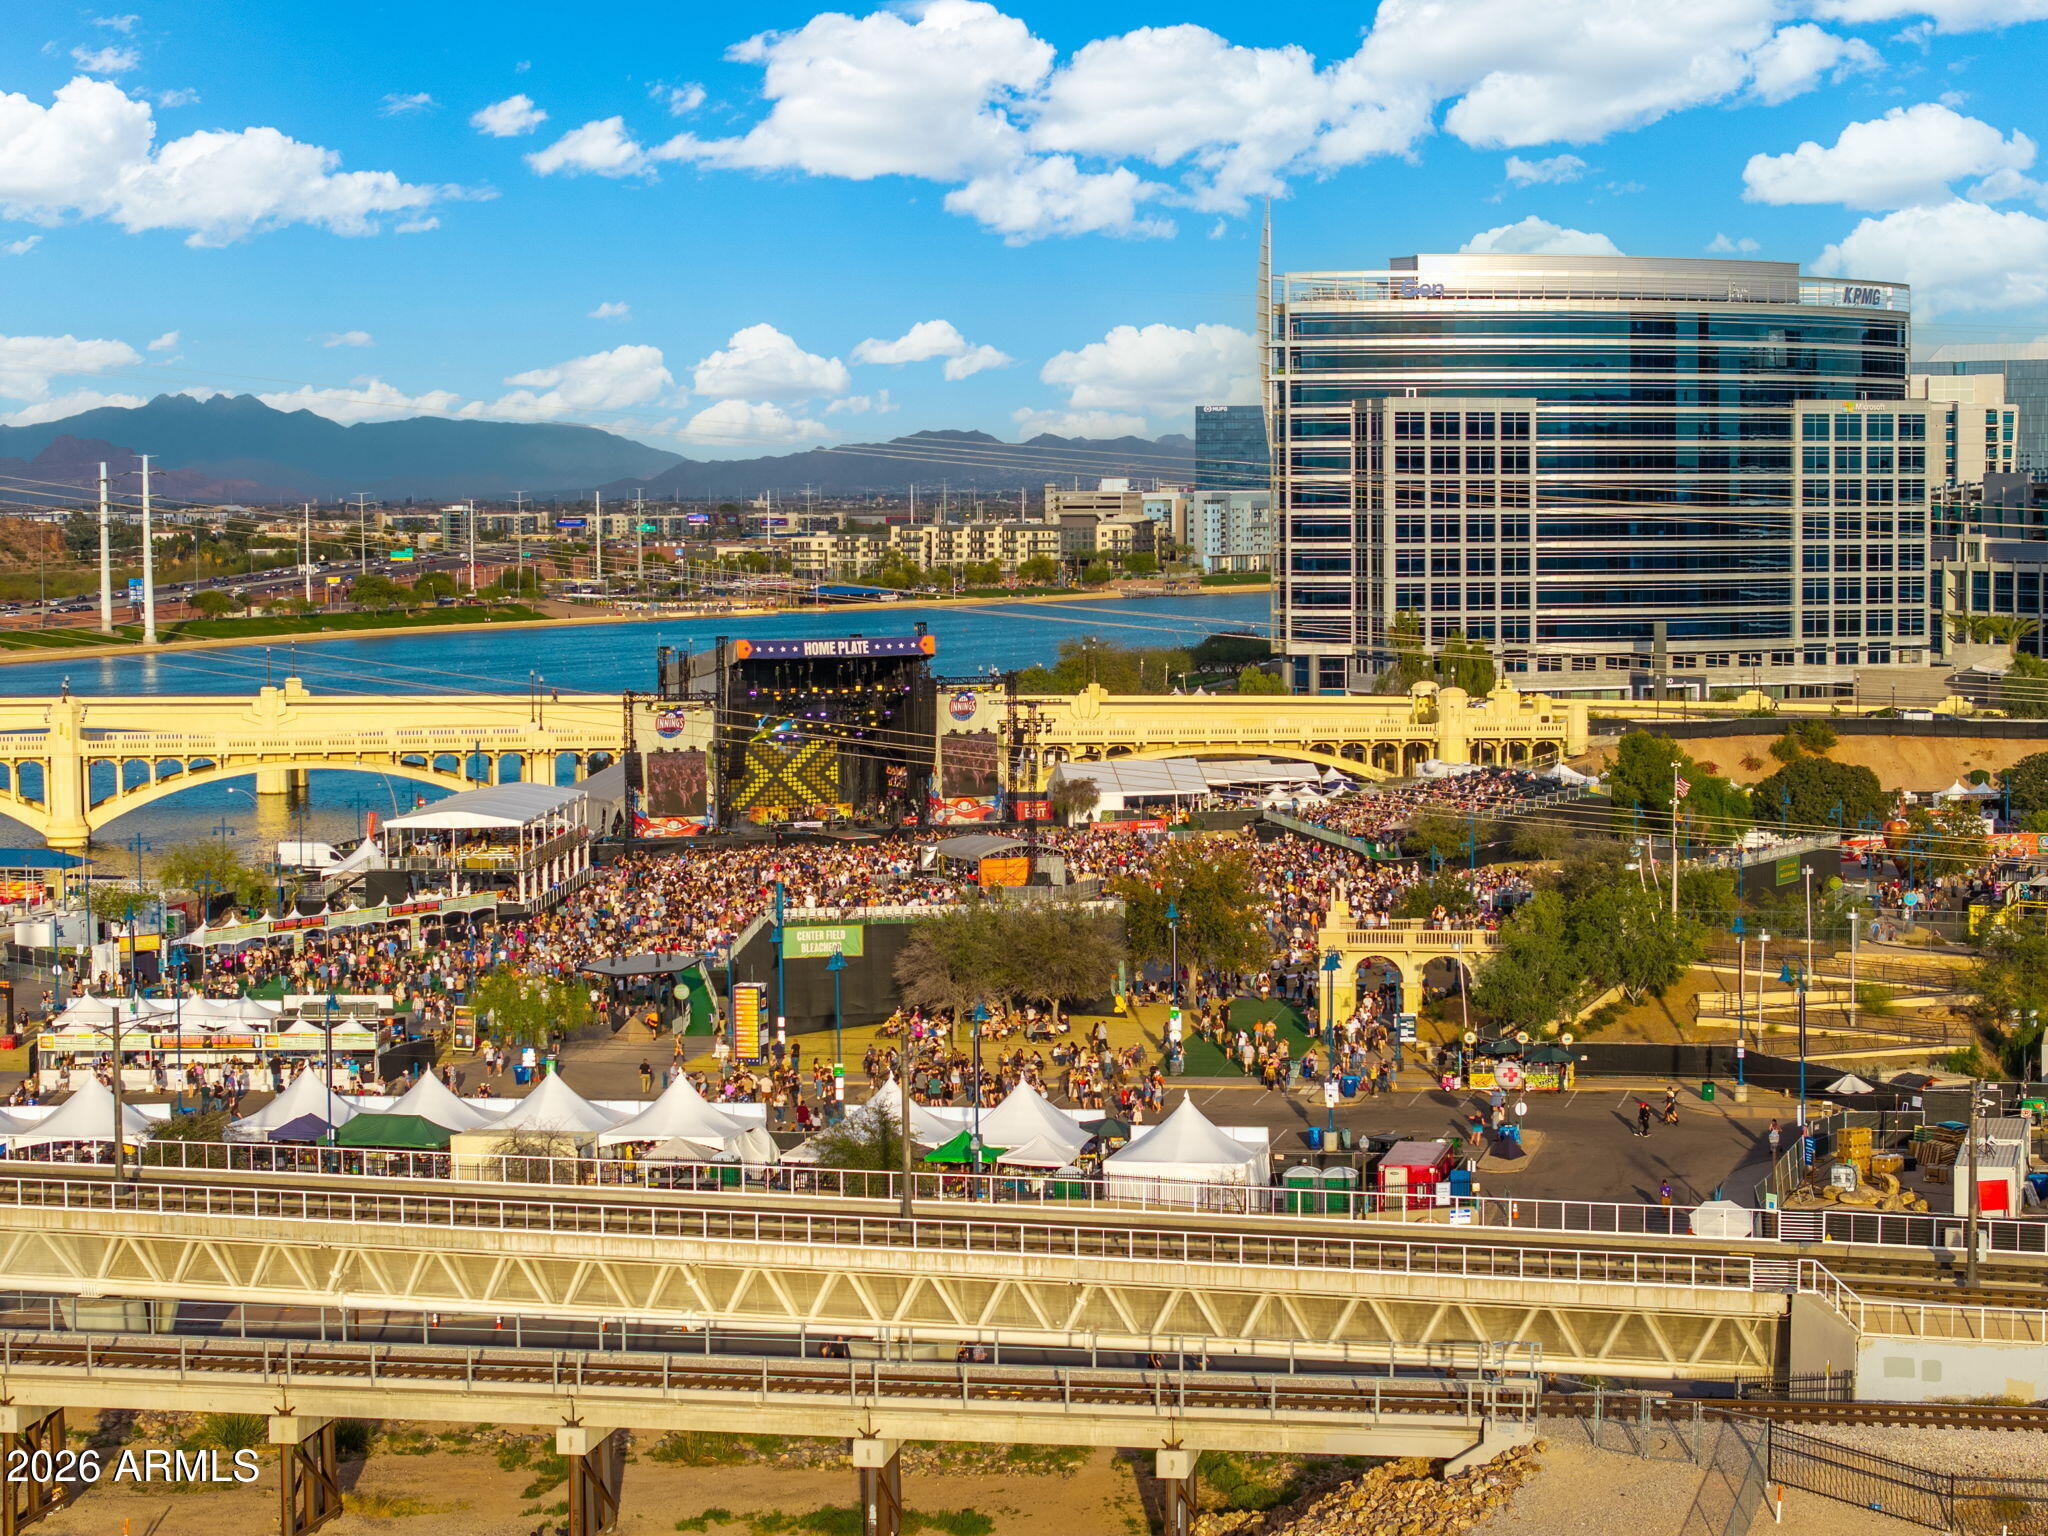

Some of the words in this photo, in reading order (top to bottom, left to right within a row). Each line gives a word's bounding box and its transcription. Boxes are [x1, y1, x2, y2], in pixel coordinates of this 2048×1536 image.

[1401, 278, 1444, 298] Gen
[1843, 286, 1881, 305] KPMG
[1856, 403, 1885, 411] Microsoft
[804, 642, 836, 656] HOME
[838, 641, 869, 655] PLATE
[949, 700, 976, 712] INNINGS
[657, 716, 684, 729] INNINGS
[1025, 807, 1047, 818] EXIT
[796, 930, 824, 941] CENTER
[826, 930, 846, 940] FIELD
